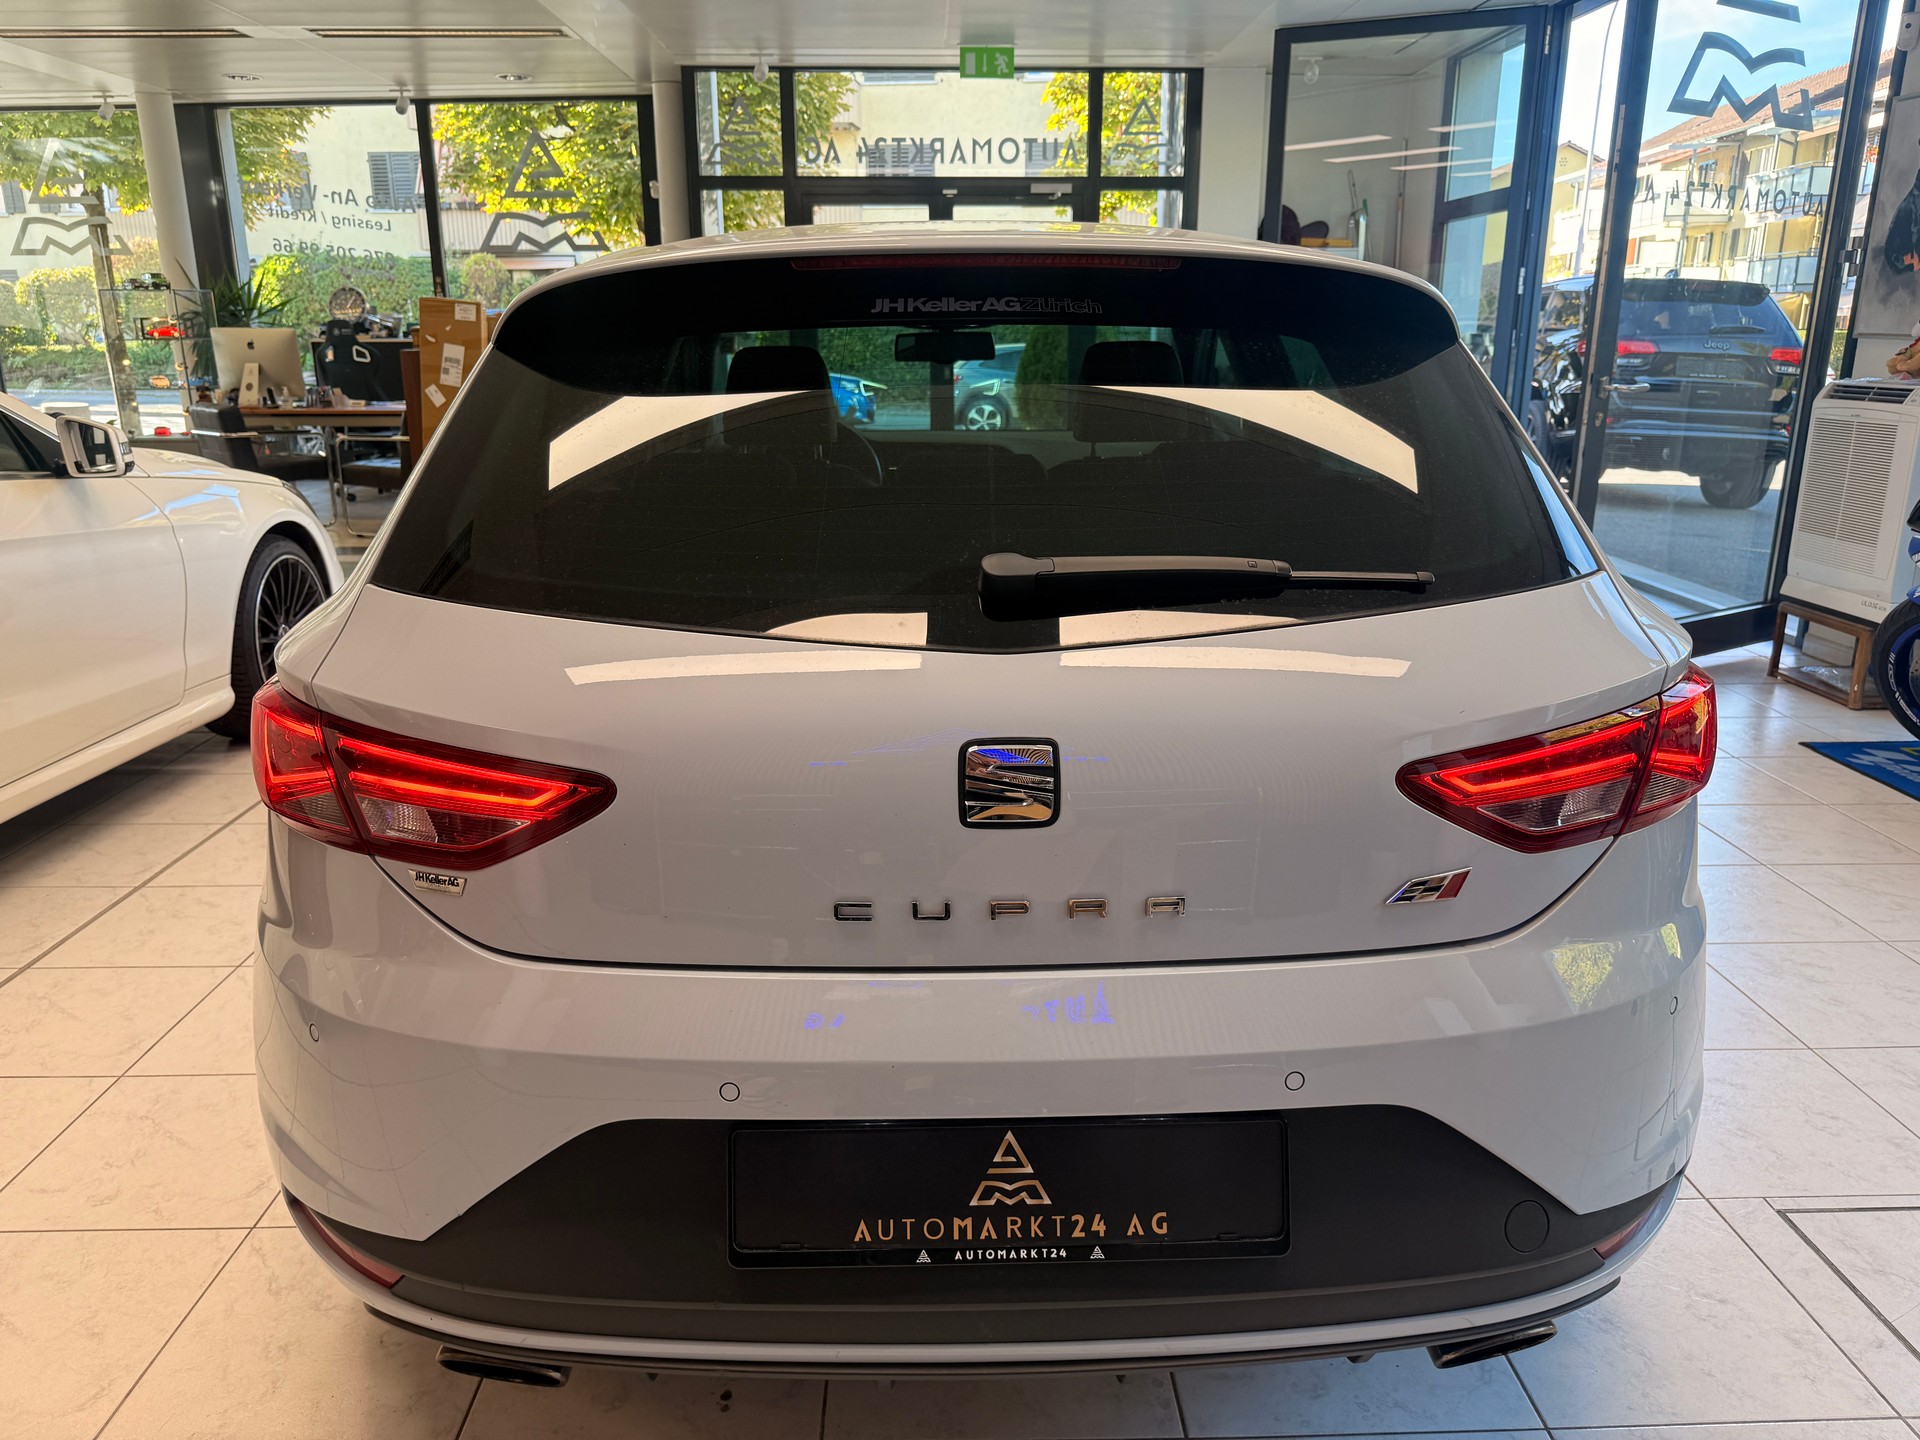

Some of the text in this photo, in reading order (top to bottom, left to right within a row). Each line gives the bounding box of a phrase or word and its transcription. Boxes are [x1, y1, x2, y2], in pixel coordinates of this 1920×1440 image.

[1703, 340, 1730, 351] Jeep
[833, 896, 1186, 922] CUPRA
[854, 1211, 1168, 1242] AUTOMARKT24 AG
[955, 1248, 1067, 1260] AUTOMARKT24
